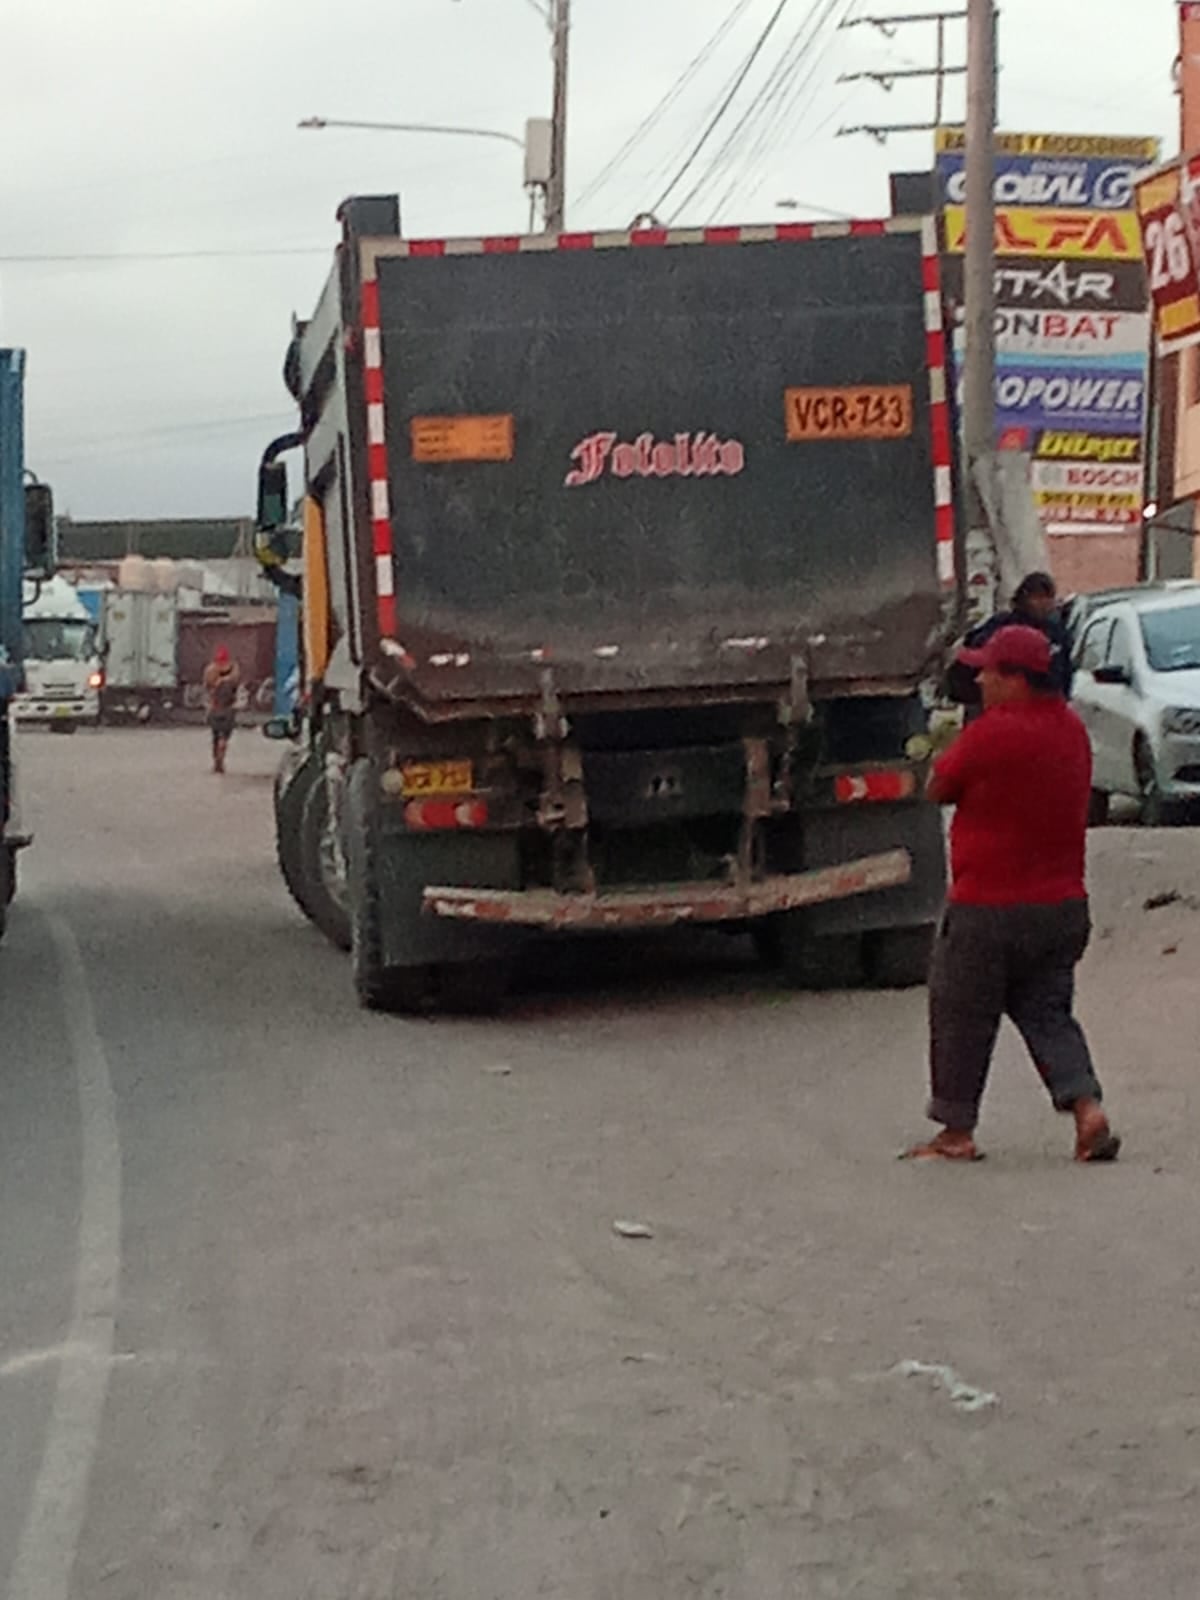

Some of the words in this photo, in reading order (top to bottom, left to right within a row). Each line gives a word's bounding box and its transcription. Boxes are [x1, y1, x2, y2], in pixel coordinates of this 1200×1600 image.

[946, 171, 1089, 204] GOBAL
[957, 376, 1143, 411] OPOWER
[1066, 468, 1139, 486] BOSCH
